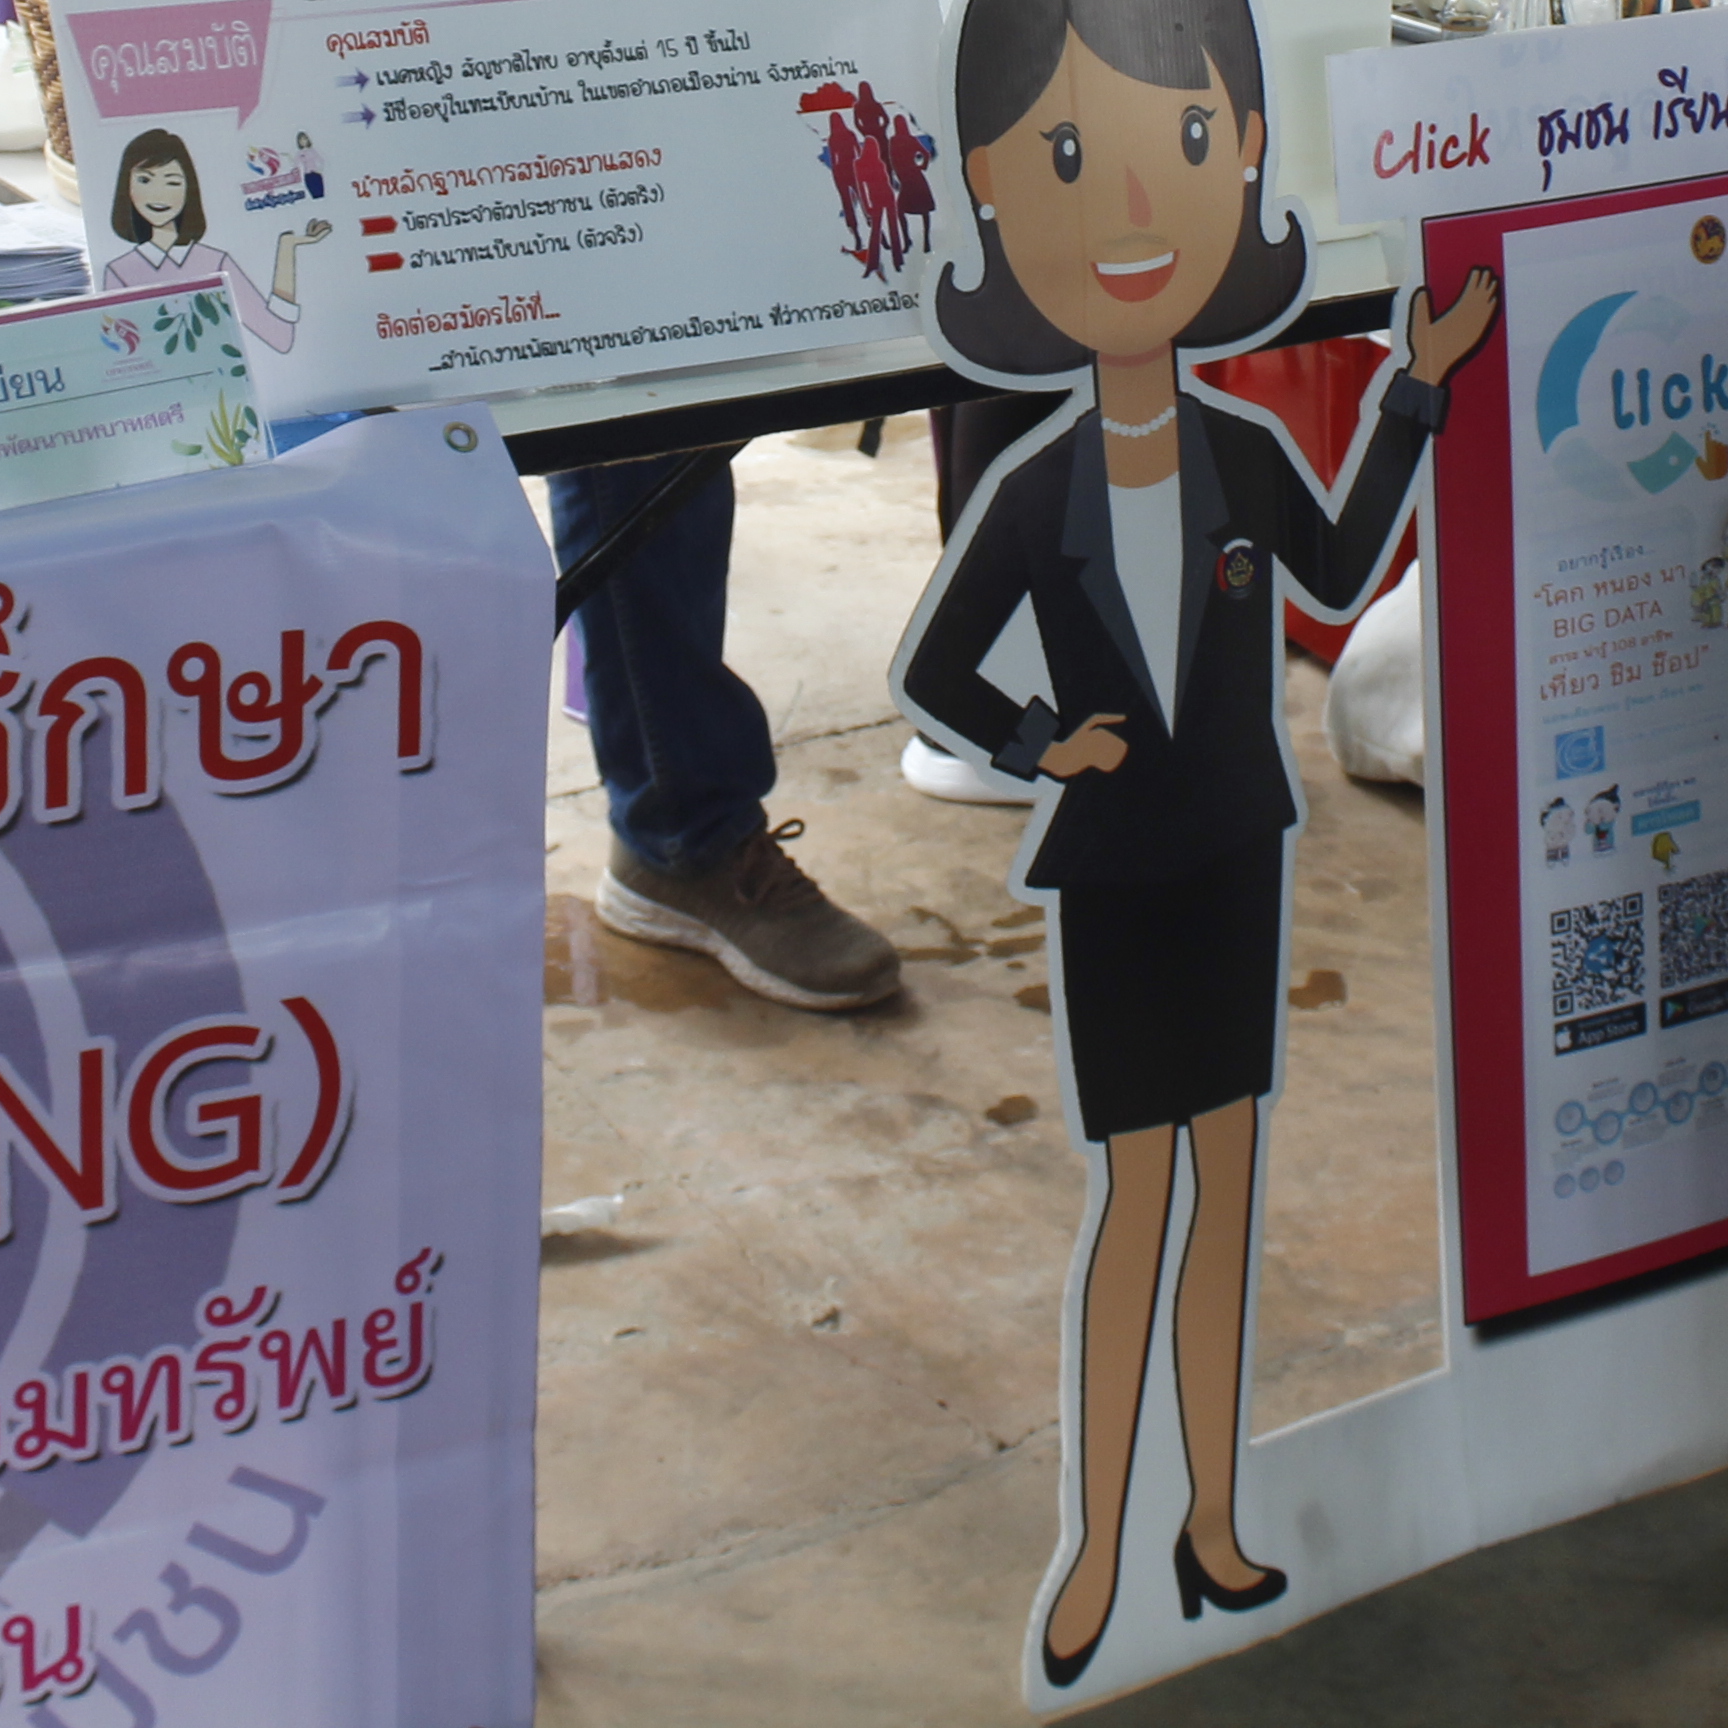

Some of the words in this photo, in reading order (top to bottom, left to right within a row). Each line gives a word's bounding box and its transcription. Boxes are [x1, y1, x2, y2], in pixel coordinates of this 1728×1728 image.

[91, 20, 258, 94] คุณสมบัติ
[326, 20, 430, 67] คุณสมบัติ
[376, 60, 453, 86] เพศหญิง
[462, 49, 558, 81] สัญชาติไทย
[656, 38, 680, 60] 15
[685, 35, 700, 56] ปี
[767, 55, 859, 83] จังหวัดน่าน
[1373, 113, 1491, 179] Click
[1535, 101, 1630, 193] ชุมชน
[352, 146, 663, 198] นำหลักฐานการสมัครมาแสดง
[402, 197, 593, 232] บัตรประจำตัวประชาชน
[410, 233, 571, 270] สำเนาทะเบียนบ้าน
[577, 223, 643, 251] (ตัวจริง)
[1593, 572, 1652, 598] หนอง
[1660, 564, 1686, 583] นา
[1554, 613, 1595, 638] BIG
[1605, 601, 1663, 628] DATA
[1540, 667, 1600, 701] เที่ยว
[1610, 663, 1642, 686] ชิม
[1578, 1027, 1604, 1046] App
[1606, 1019, 1640, 1039] Store
